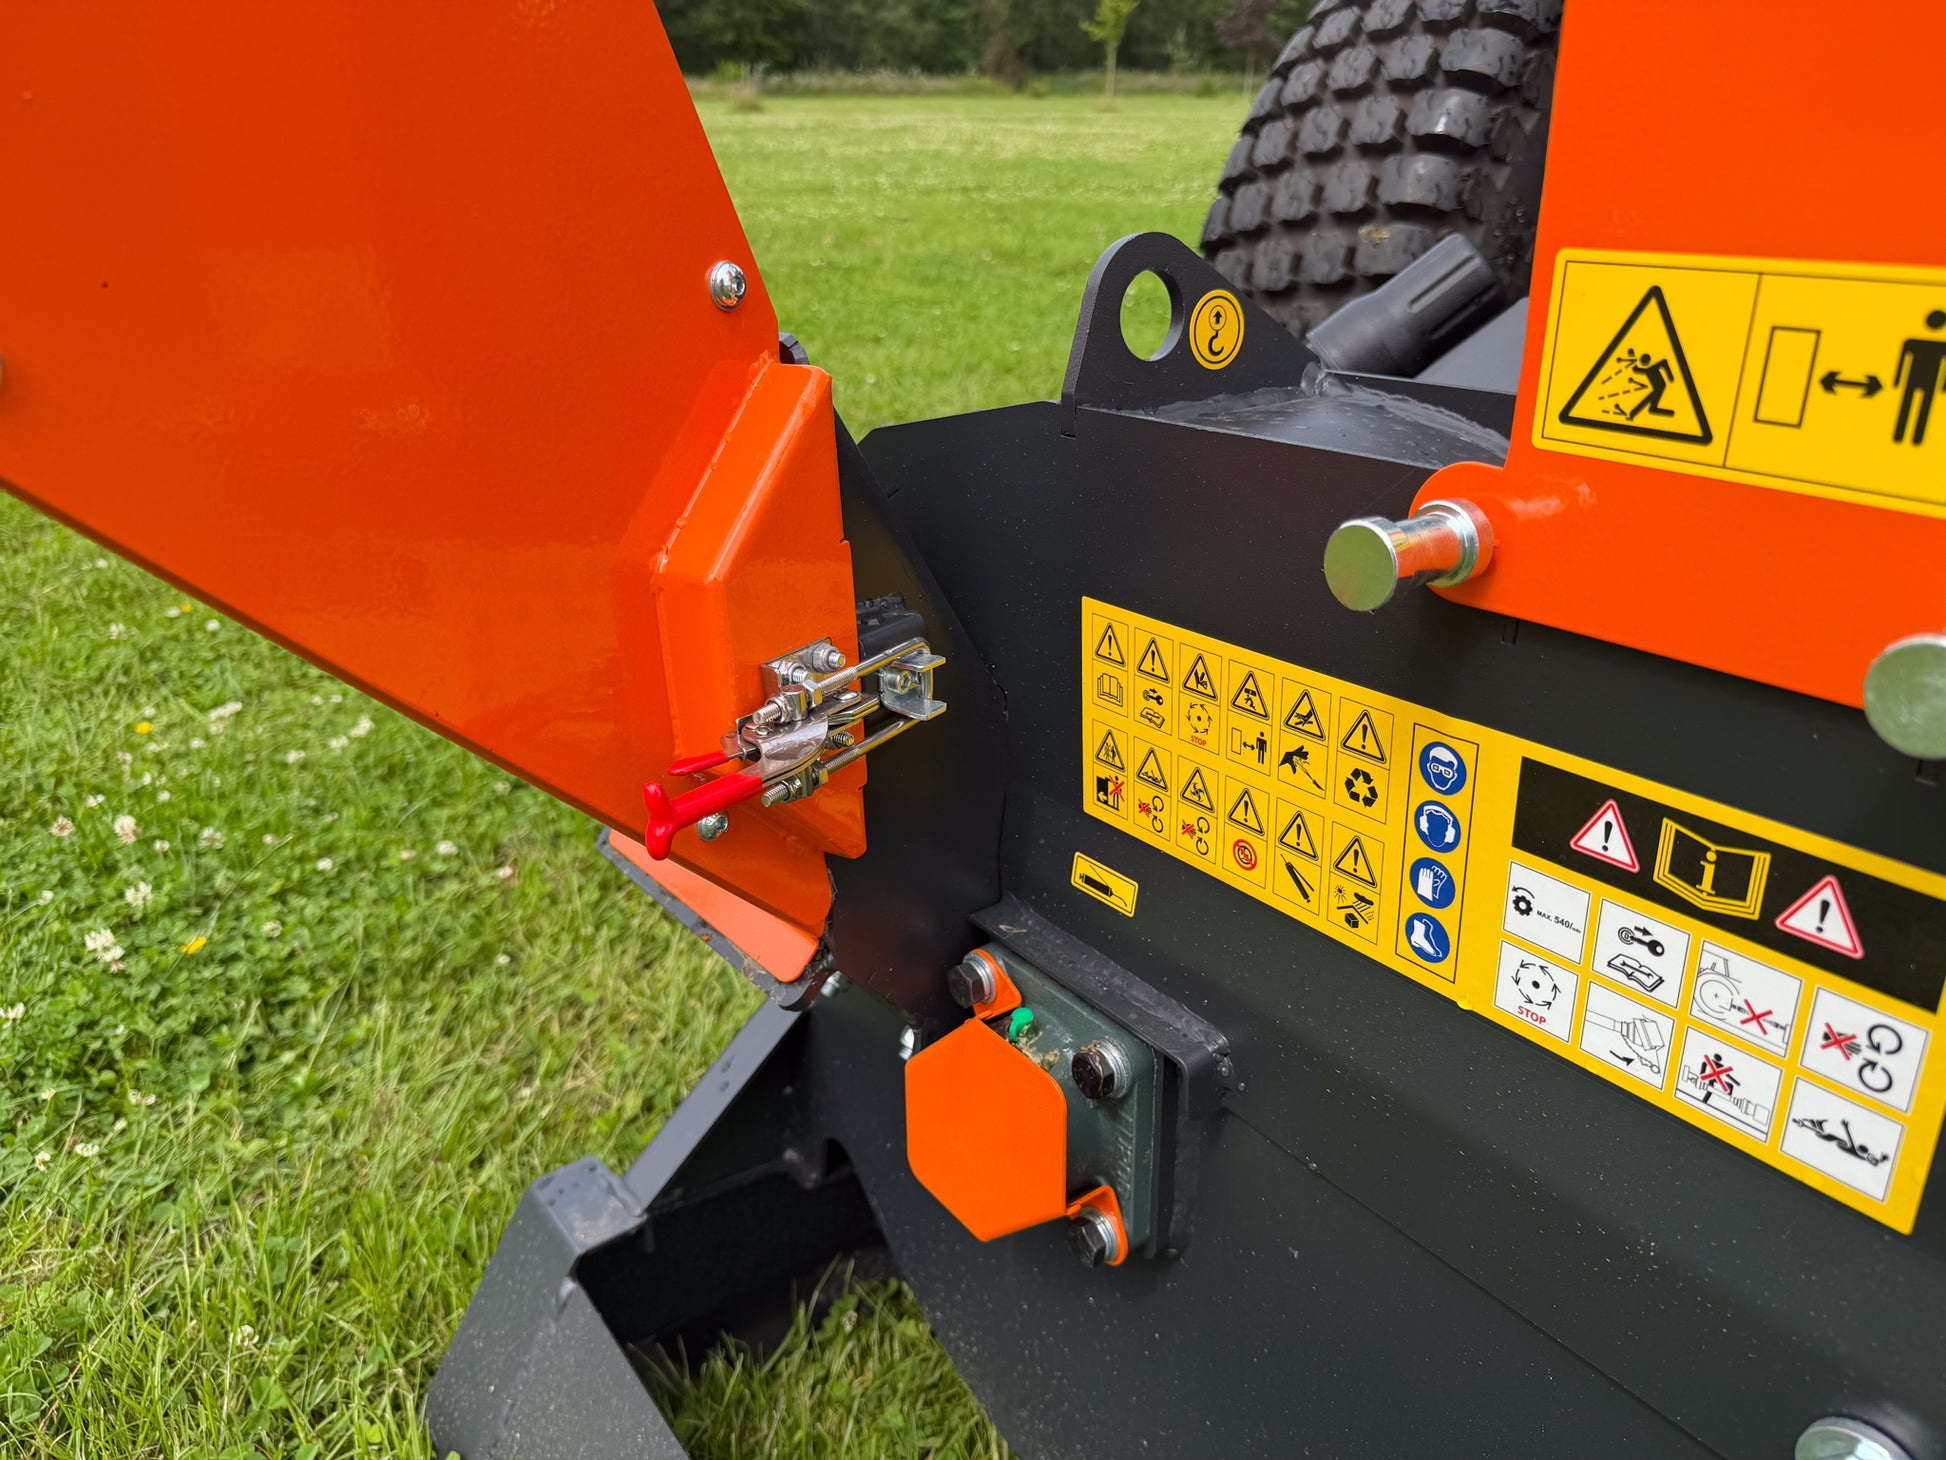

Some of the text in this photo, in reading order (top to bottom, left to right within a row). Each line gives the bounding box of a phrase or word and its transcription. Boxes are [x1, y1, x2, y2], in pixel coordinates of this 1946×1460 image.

[1190, 735, 1207, 747] STOP
[1536, 910, 1552, 921] MAX.
[1517, 1005, 1547, 1025] STOP
